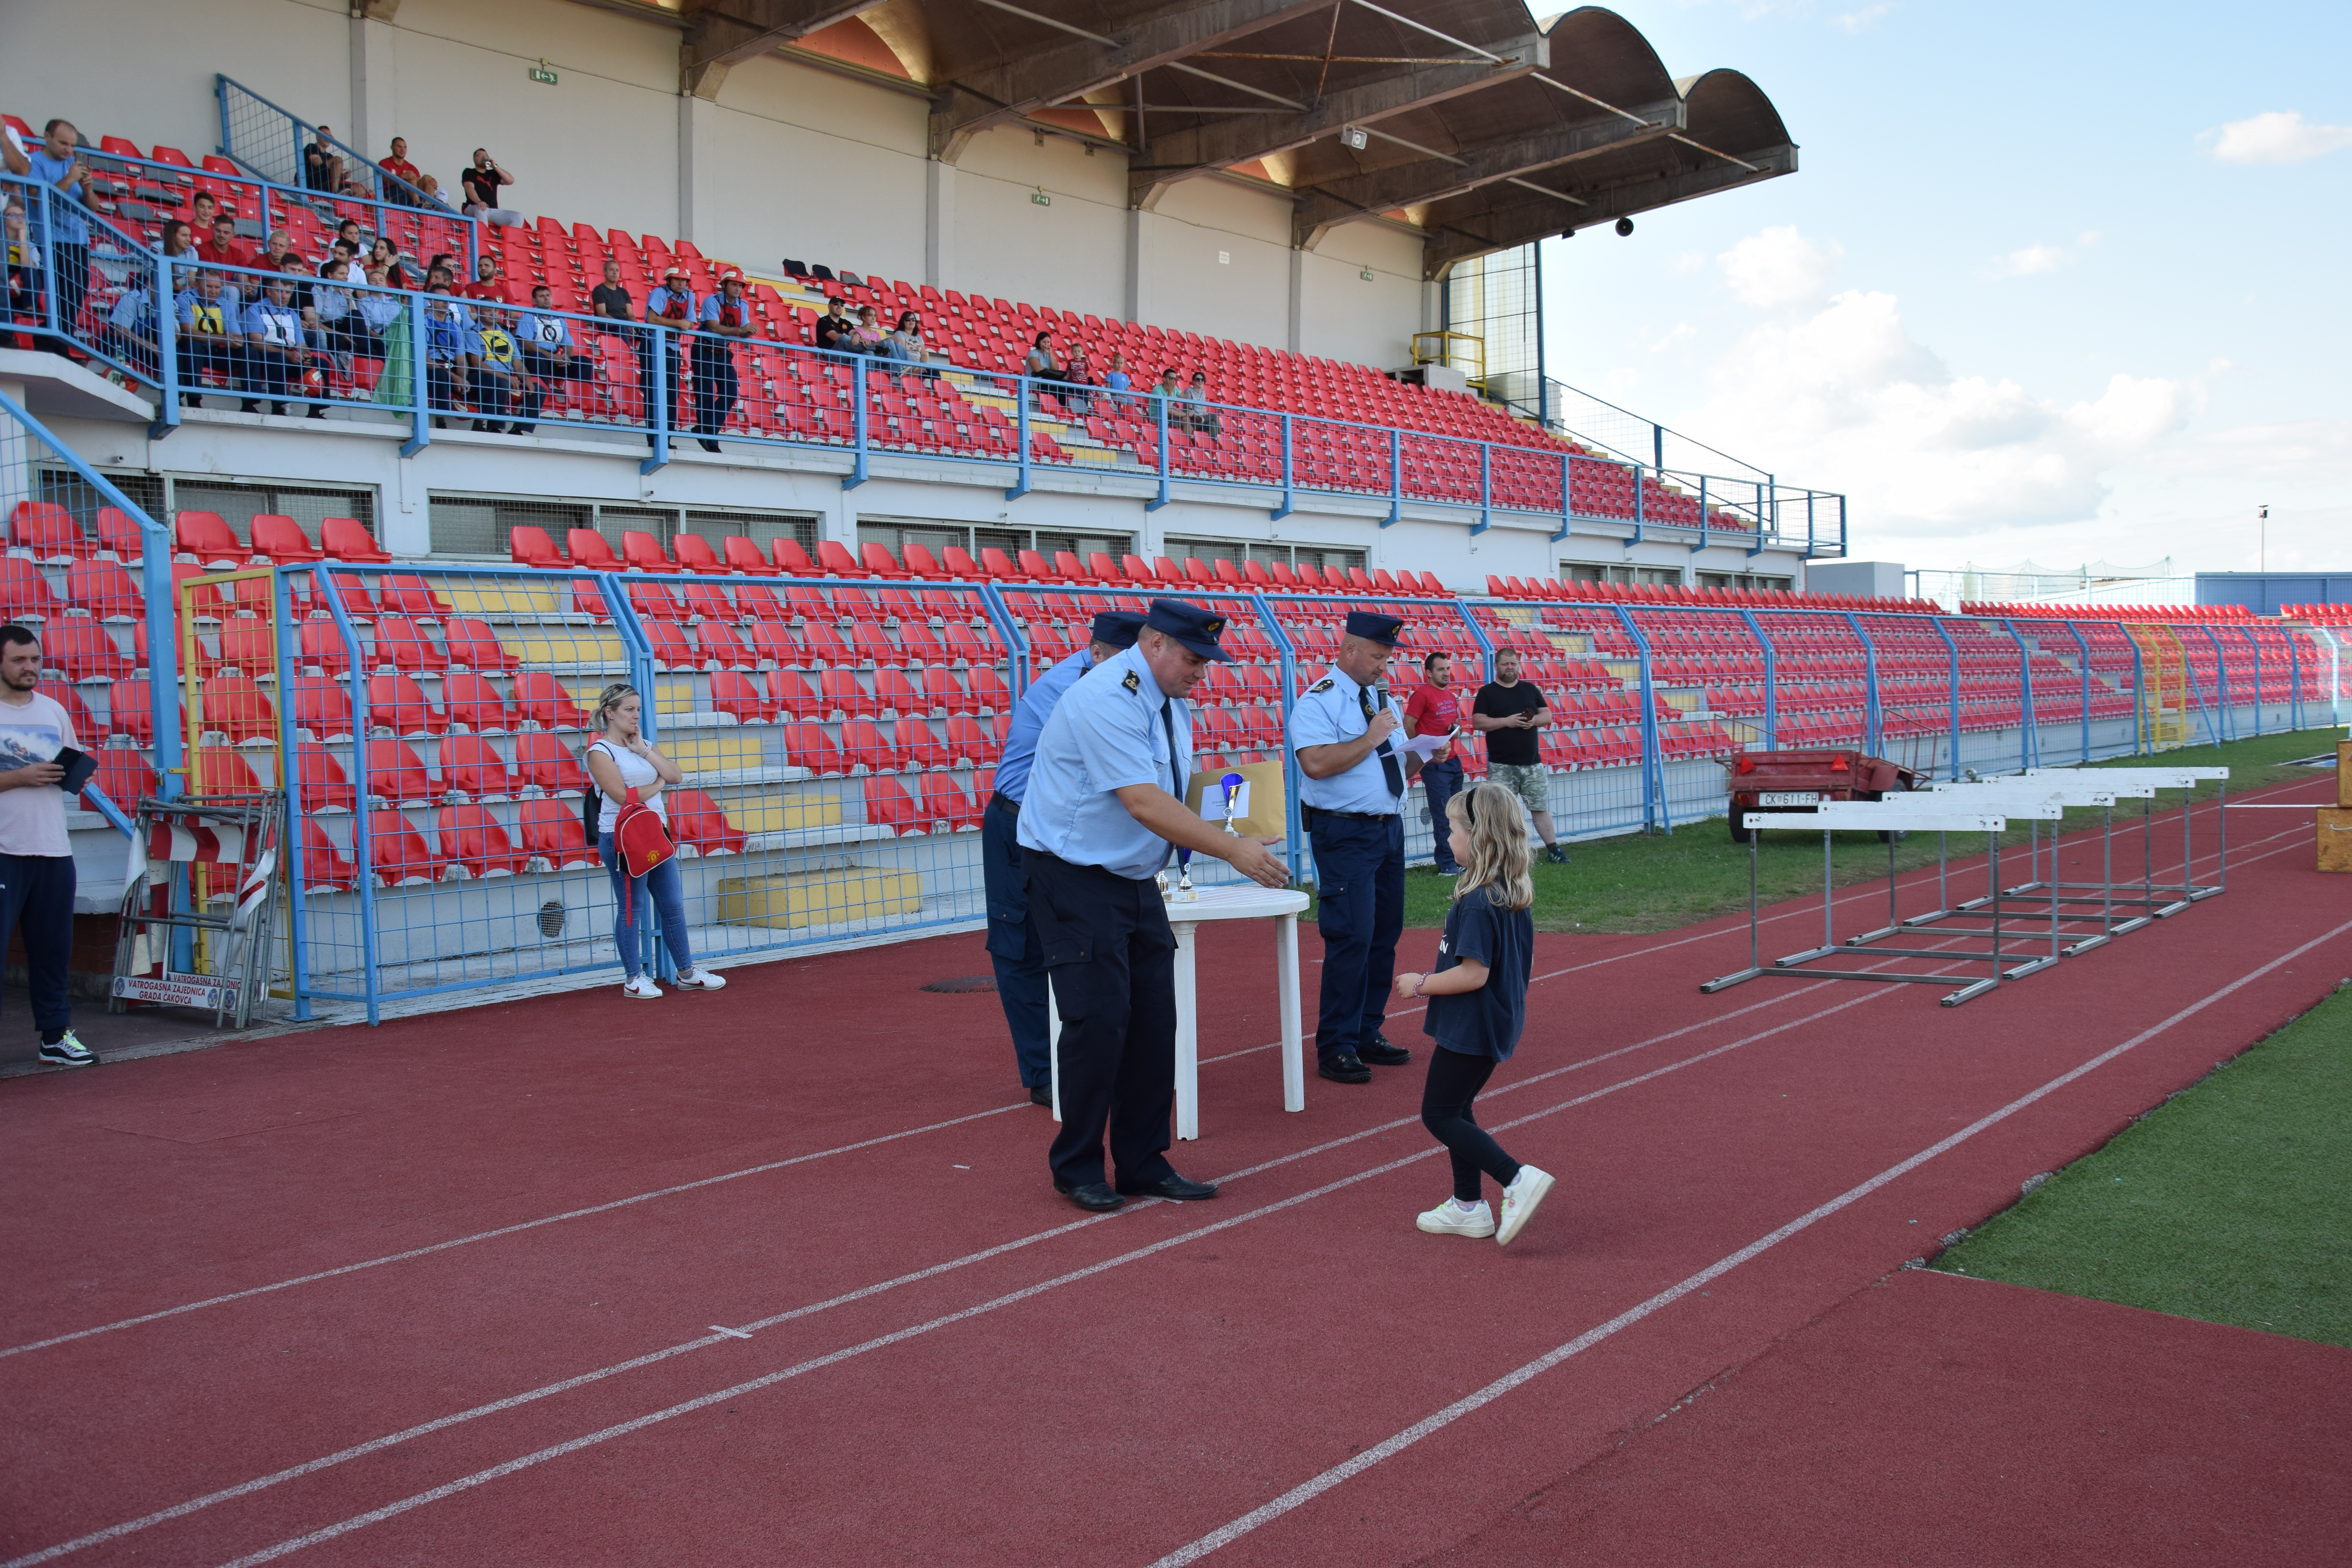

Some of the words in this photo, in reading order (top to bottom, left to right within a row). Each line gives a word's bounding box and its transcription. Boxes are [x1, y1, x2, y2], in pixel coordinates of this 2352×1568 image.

[1766, 794, 1776, 804] CK
[1784, 794, 1817, 804] 611-FH
[174, 974, 211, 986] VATROGASNA
[129, 979, 171, 992] VATROGASNA
[172, 984, 206, 996] ZAJEDNICA
[139, 991, 162, 1001] GRADA
[163, 992, 192, 1005] ČAKOVCA
